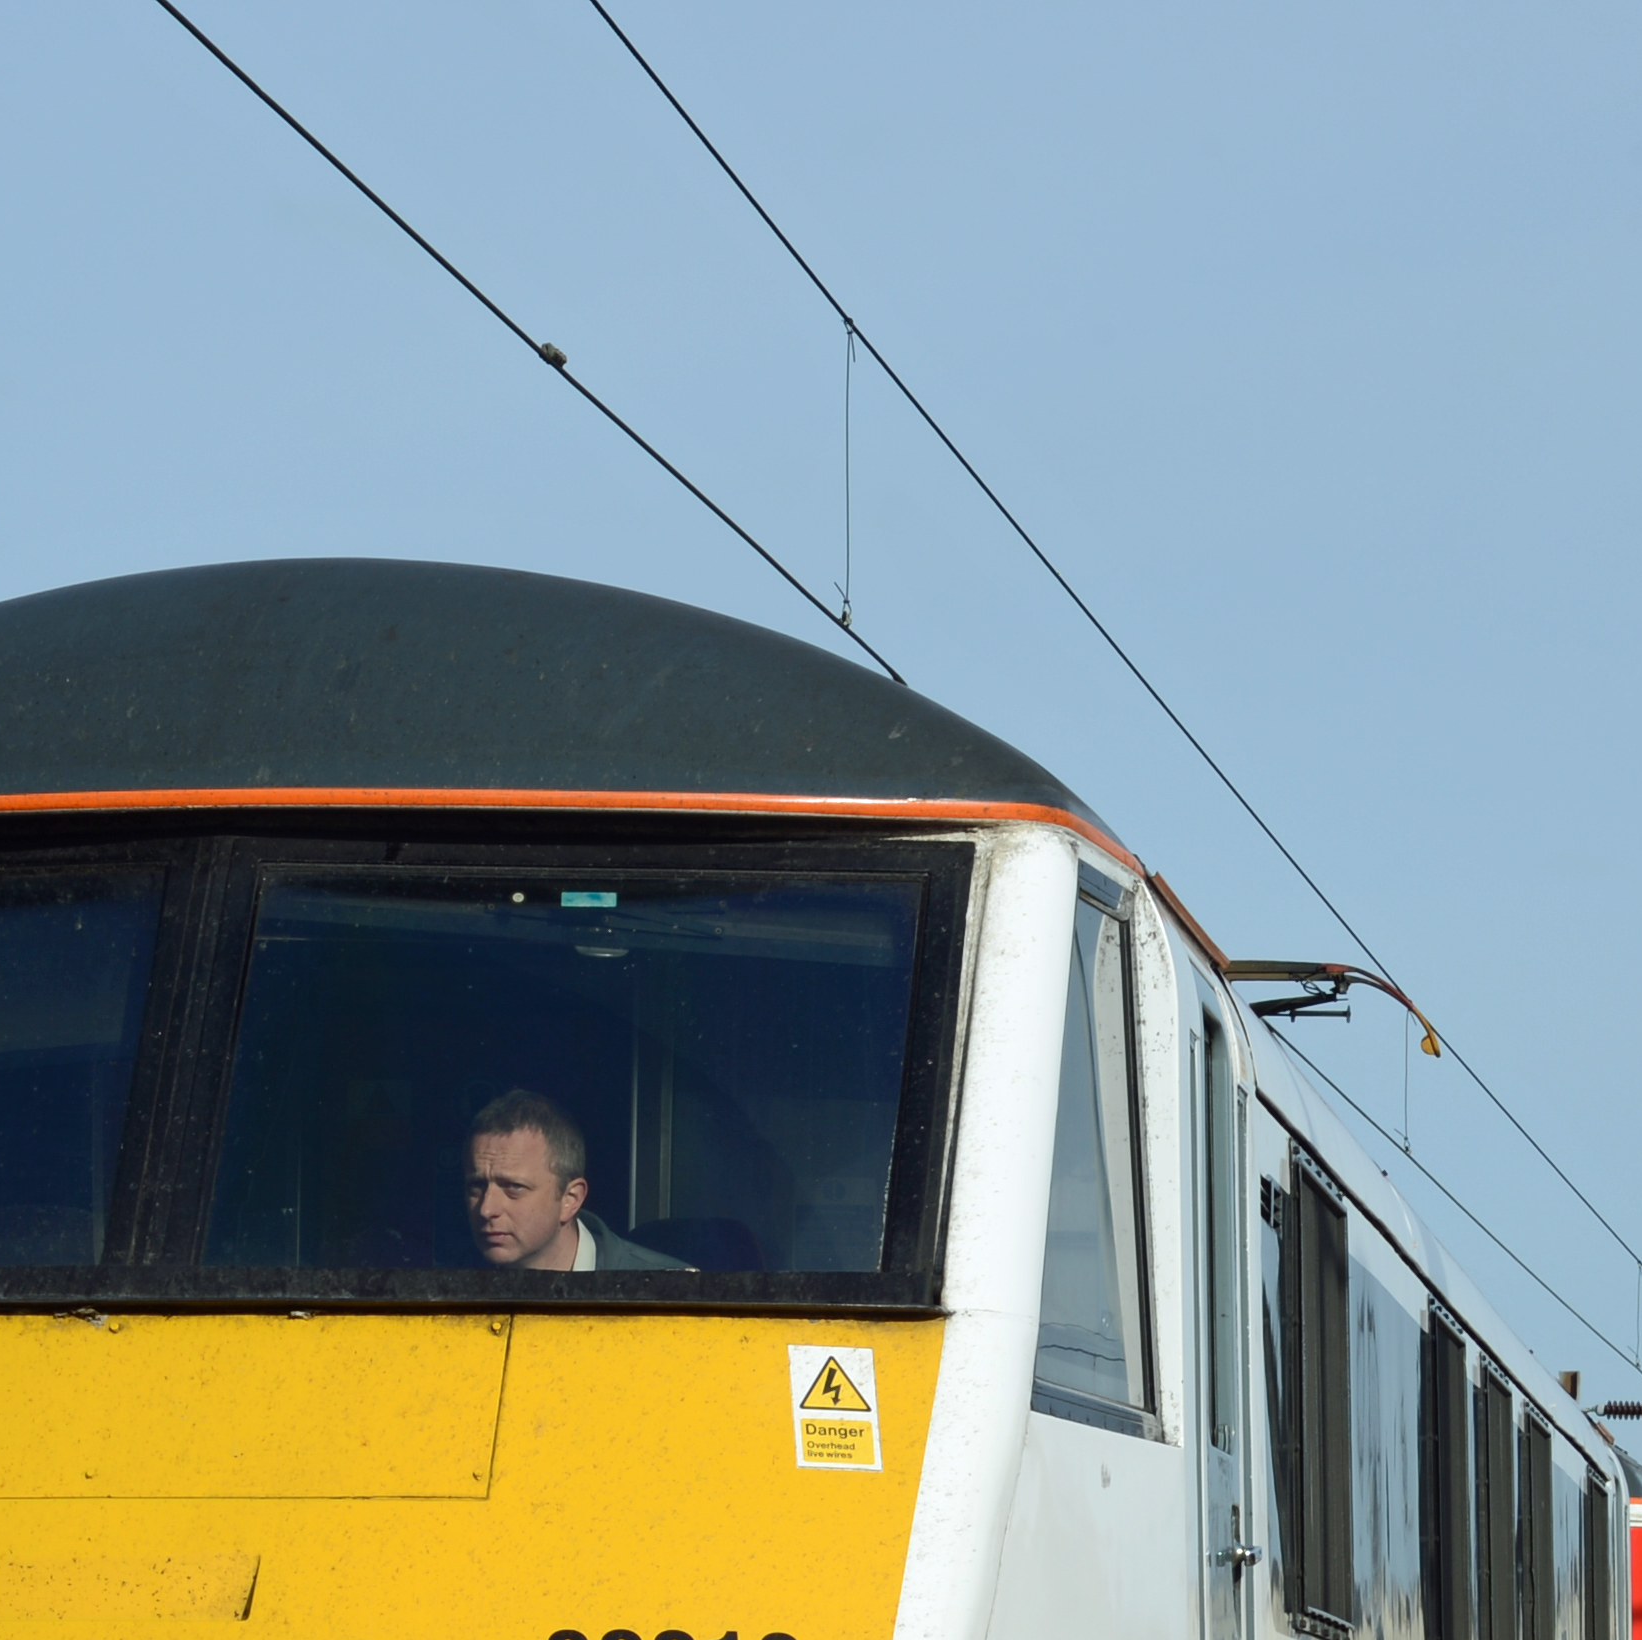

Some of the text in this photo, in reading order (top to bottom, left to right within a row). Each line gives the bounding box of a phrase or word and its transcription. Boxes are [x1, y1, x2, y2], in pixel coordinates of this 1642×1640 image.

[805, 1423, 865, 1439] Danger
[807, 1440, 855, 1451] Overhead
[807, 1450, 853, 1459] live wires
